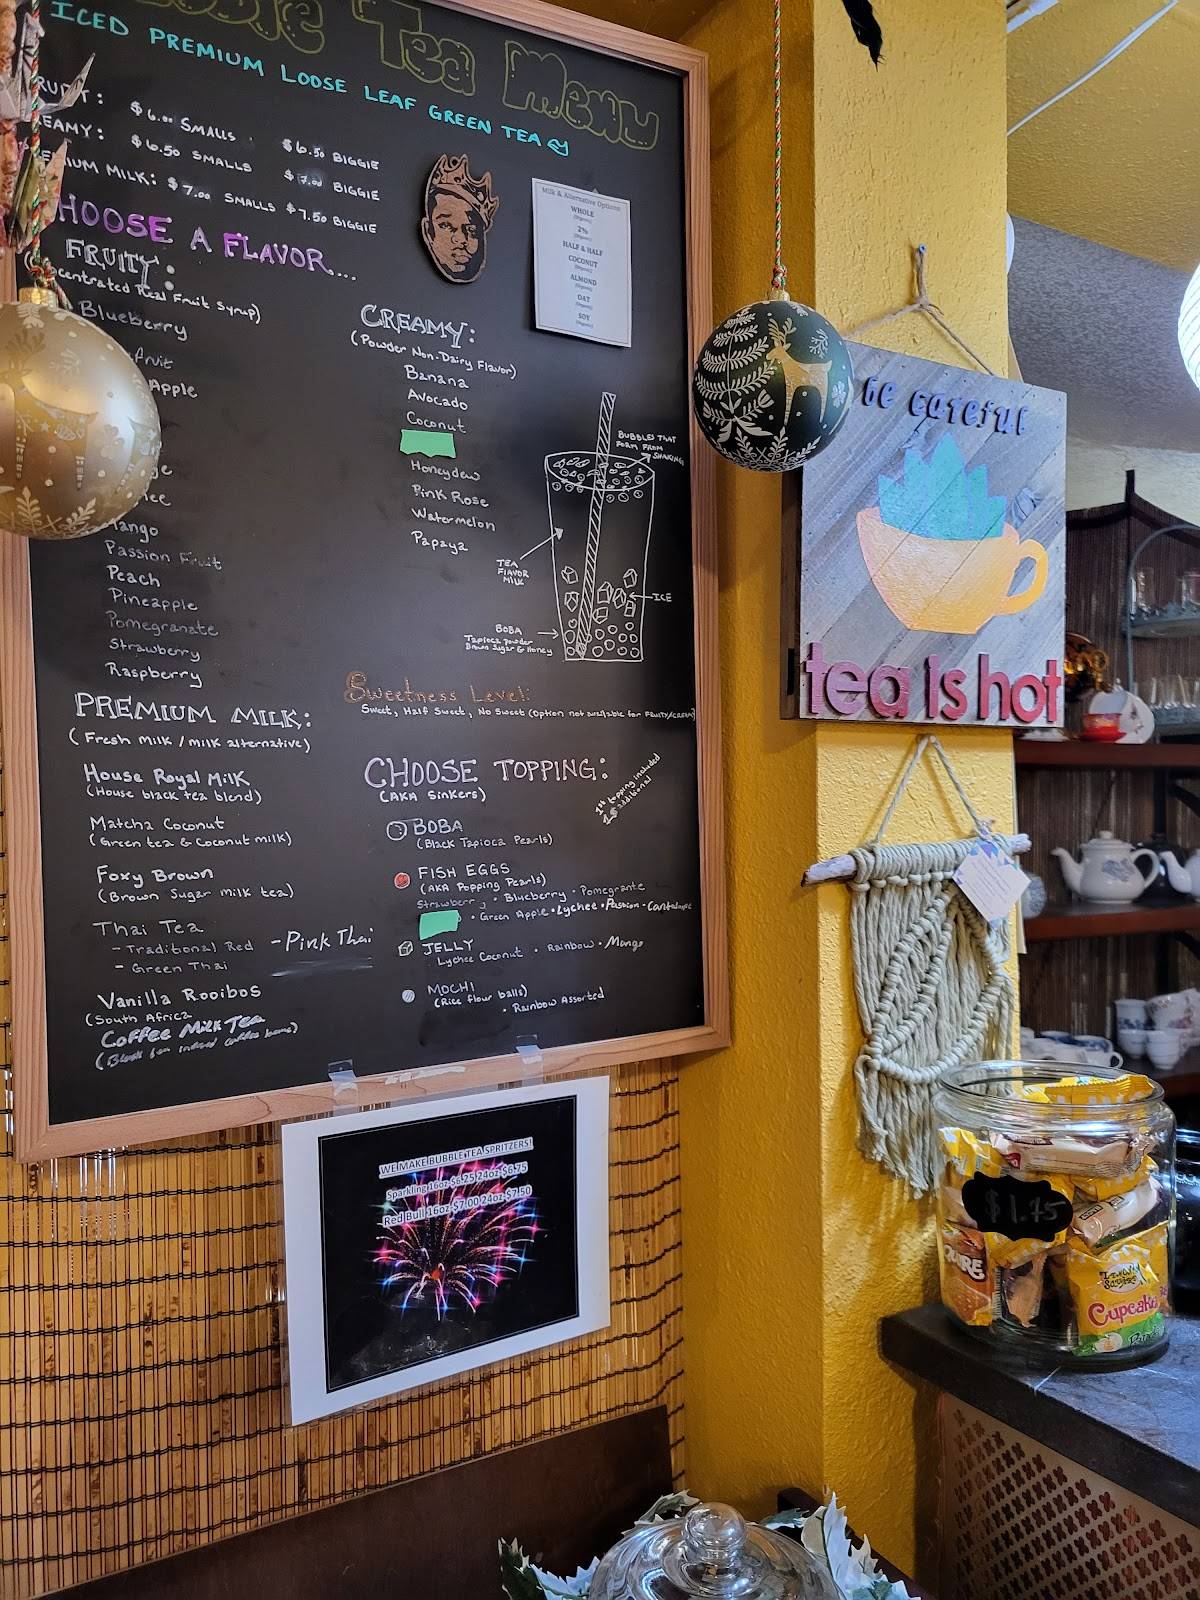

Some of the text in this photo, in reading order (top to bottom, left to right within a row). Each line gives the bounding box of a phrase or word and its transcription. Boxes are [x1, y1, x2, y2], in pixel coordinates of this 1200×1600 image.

[50, 0, 129, 36] ICED
[149, 27, 265, 77] PREMIUM
[281, 64, 347, 93] LOOSE
[364, 86, 416, 110] LEAF
[428, 105, 492, 134] GREEN
[502, 126, 541, 146] TEA
[503, 40, 660, 150] Menu
[332, 152, 379, 170] BIGGIE
[192, 150, 379, 201] SMALLS BIGGIE
[106, 164, 377, 233] MILK: SMALLS BIGGIE
[58, 192, 173, 243] HOOSE
[190, 226, 213, 253] A
[66, 238, 176, 290] FRUITY:
[568, 255, 598, 269] COCONUT
[570, 273, 597, 287] ALMOND
[172, 292, 210, 309] Fruit
[216, 300, 261, 324] Syrup)
[79, 300, 188, 341] Blueberry
[360, 304, 476, 349] CREAMY:
[350, 330, 407, 354] (Powder
[477, 360, 517, 380] Flavor)
[404, 364, 469, 389] Banana
[150, 378, 198, 399] Apple
[407, 388, 468, 411] Avocado
[406, 411, 467, 434] Coconut
[411, 460, 481, 481] Honeydew
[412, 484, 489, 508] Pink Rose
[411, 508, 496, 532] Watermelon
[105, 540, 170, 563] Passion
[411, 530, 469, 555] Papaya
[496, 559, 519, 569] TEA
[106, 564, 161, 588] Peach
[108, 588, 198, 612] Pineapple
[652, 592, 672, 602] ICE
[106, 611, 219, 637] Pomegranate
[495, 624, 523, 636] BOBA
[109, 638, 200, 663] Strawberry
[105, 662, 203, 689] Raspberry
[806, 641, 1062, 723] tea is hot
[344, 671, 457, 704] Sweetness
[75, 692, 312, 730] PREMIUM MILK:
[403, 706, 430, 717] Half
[478, 707, 492, 716] No
[495, 707, 526, 717] Sweet
[227, 738, 311, 753] alternative)
[84, 763, 143, 784] House
[153, 768, 201, 791] Royal
[364, 757, 609, 789] CHOOSE TOPPING:
[86, 784, 263, 805] (House black tea blend)
[379, 786, 487, 804] (AKA Sinkers)
[90, 816, 225, 831] Matcha Coconut
[413, 819, 463, 836] BOBA
[89, 833, 142, 848] (Green
[147, 837, 175, 848] tea
[195, 833, 251, 846] Coconut
[417, 834, 553, 849] (Black Tapioca Pearls)
[96, 865, 214, 889] Foxy Brown
[418, 863, 511, 879] FISH EGGS
[98, 884, 294, 904] (Brown Sugar tea)
[420, 873, 547, 895] (AKA Popping Pearls)
[504, 891, 568, 904] Blueberry
[480, 913, 510, 921] Green
[557, 902, 598, 918] Lychee
[92, 919, 204, 938] Thai Tea
[285, 925, 374, 952] Pink Thai
[126, 941, 254, 955] Traditional Red
[421, 939, 475, 956] JELLY
[437, 955, 475, 968] Lychee
[479, 947, 524, 962] Coconut
[547, 940, 595, 953] Rainbow
[131, 961, 229, 974] Green Thai
[98, 984, 261, 1010] Vanilla Rooibos
[427, 982, 475, 996] MOCHI
[434, 984, 529, 1009] (Rice flour balls)
[512, 986, 605, 1014] Rainbow Assorted
[85, 1012, 193, 1026] (South Africa
[224, 1014, 265, 1033] Tea
[400, 1138, 532, 1171] MAKE BUBBLE TEA SPRITZERS!
[387, 1185, 427, 1199] Sparkling
[384, 1209, 425, 1226] Red Bull
